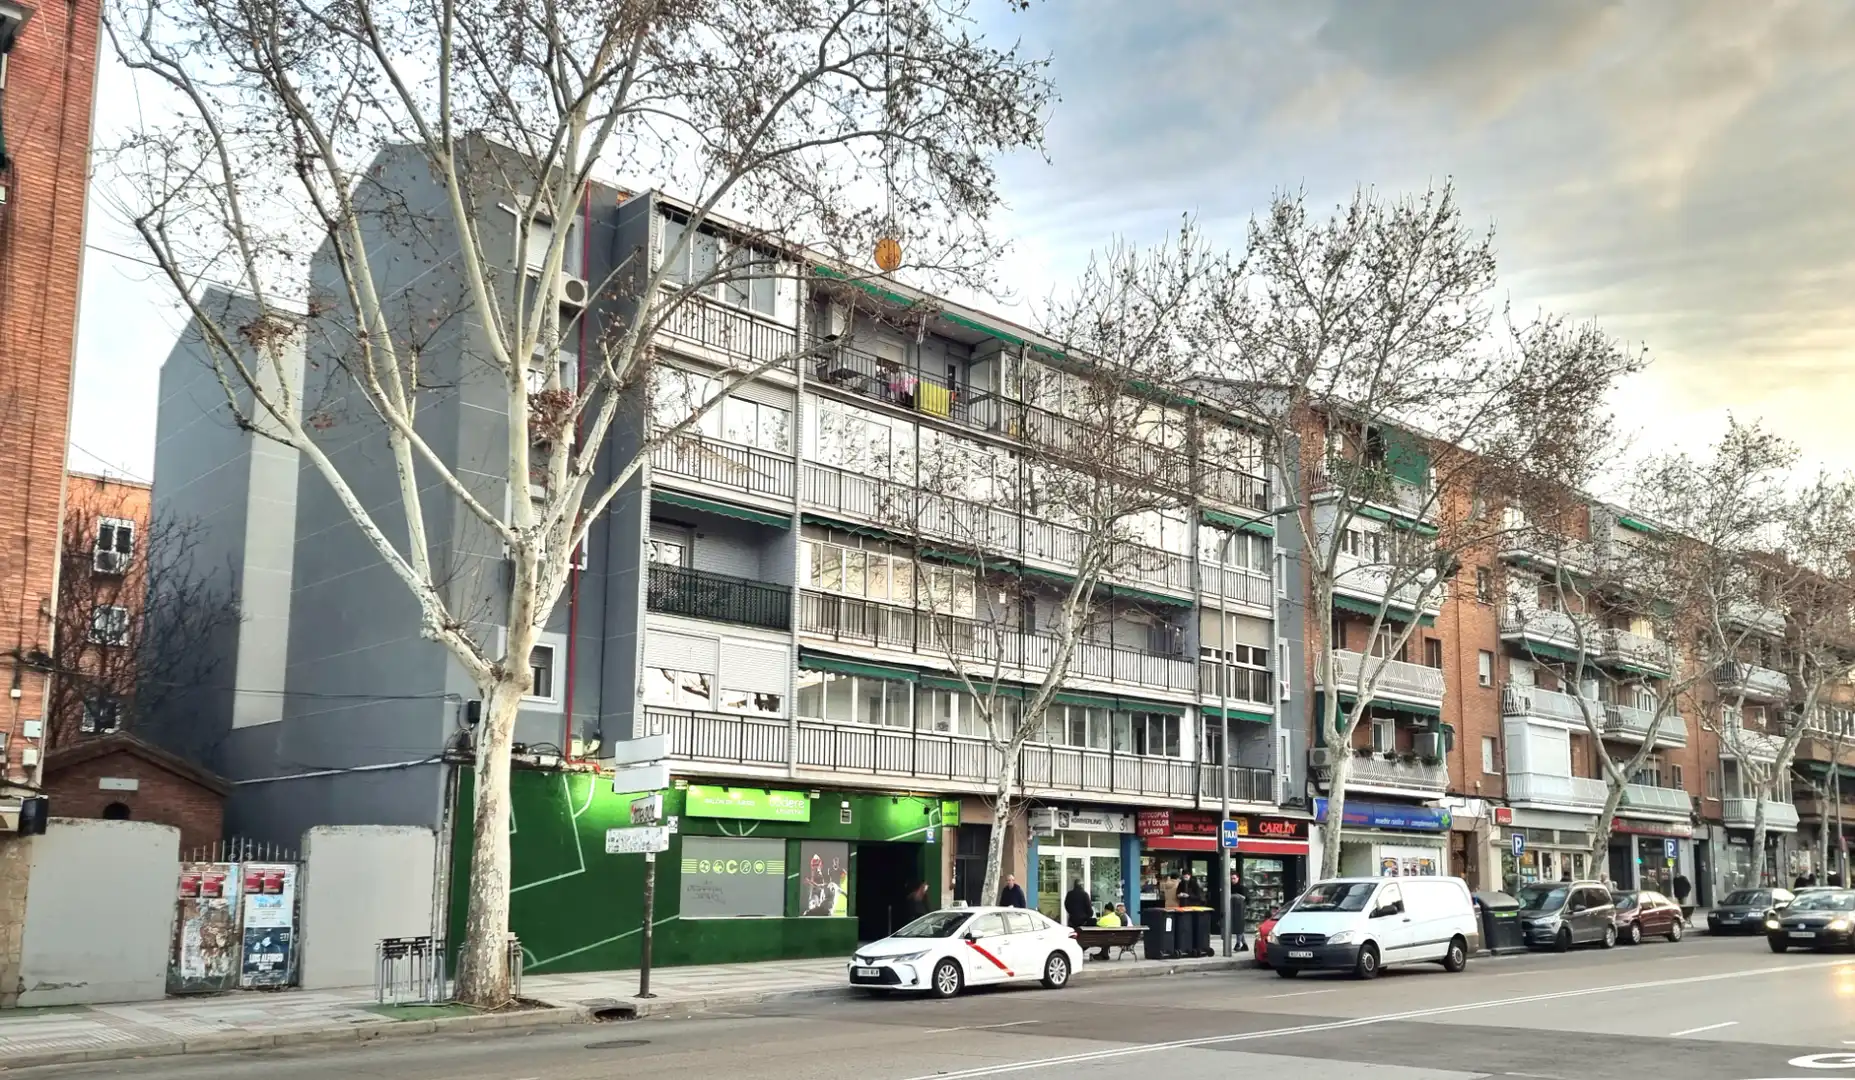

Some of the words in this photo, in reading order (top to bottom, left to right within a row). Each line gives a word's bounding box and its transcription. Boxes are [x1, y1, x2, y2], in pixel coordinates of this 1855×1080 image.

[1152, 819, 1169, 827] COLOR
[1143, 827, 1164, 835] PLANOS
[1224, 830, 1238, 839] TAXI
[1514, 836, 1522, 854] P
[1667, 841, 1675, 857] P
